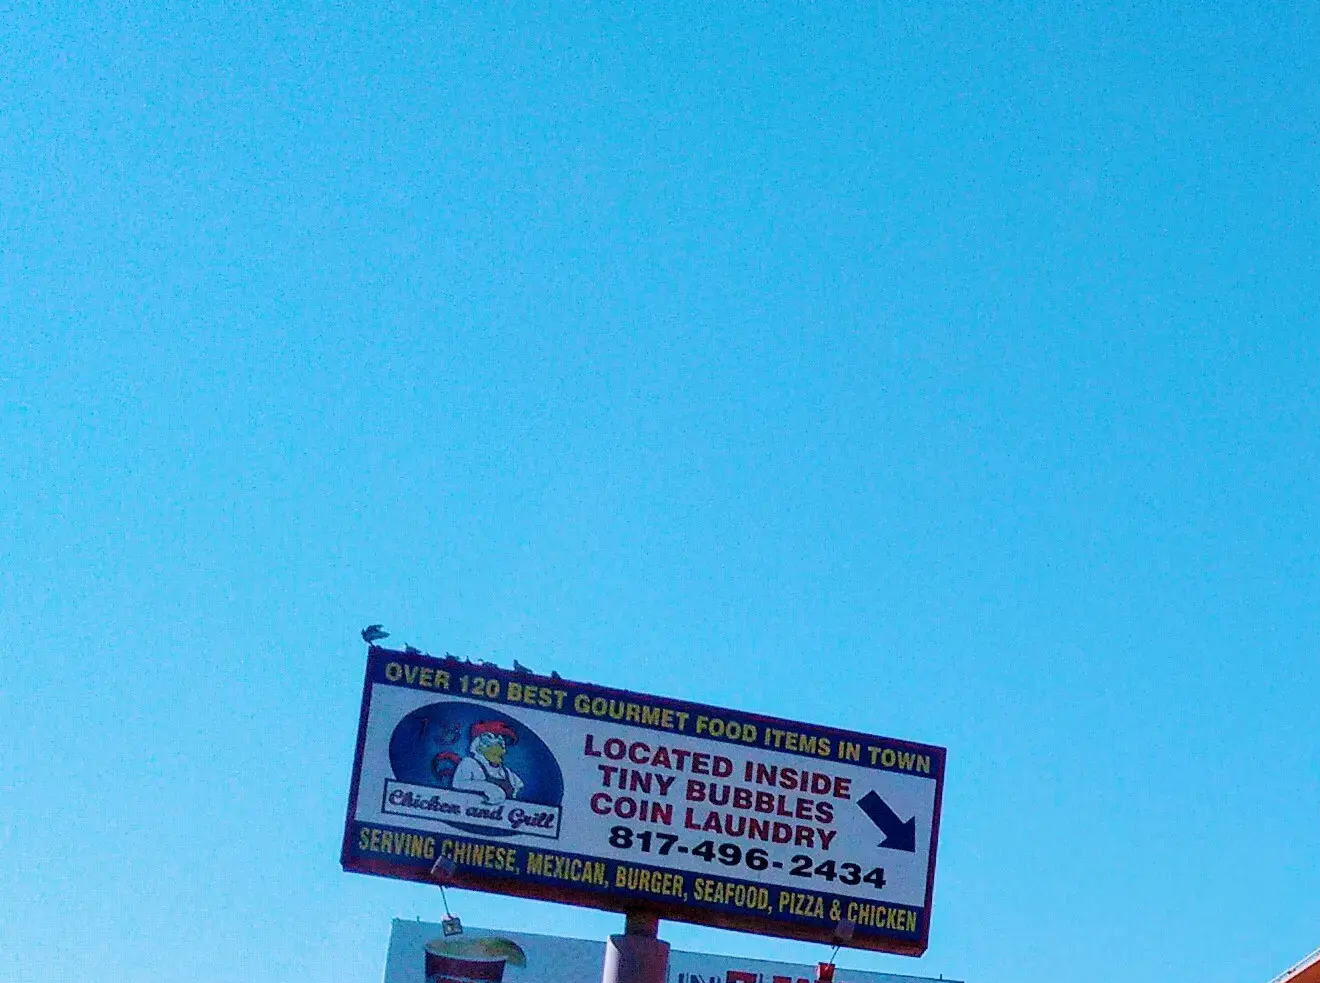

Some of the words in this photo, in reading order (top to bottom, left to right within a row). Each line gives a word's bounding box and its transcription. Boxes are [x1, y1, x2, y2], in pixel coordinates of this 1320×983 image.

[385, 662, 451, 690] OVER
[459, 675, 501, 698] 120
[507, 681, 568, 710] BEST
[574, 694, 689, 731] GOURMET
[696, 715, 757, 743] FOOD
[764, 728, 831, 757] ITEMS
[838, 741, 860, 762] IN
[868, 746, 931, 773] TOWN
[584, 734, 733, 778] LOCATED
[744, 761, 852, 800] INSIDE
[598, 764, 675, 796] TINY
[686, 779, 834, 824] BUBBLES
[388, 789, 461, 816] Chicken
[465, 803, 503, 821] and
[507, 808, 555, 829] Grill
[590, 792, 673, 826] COIN
[684, 807, 837, 850] LAUNDRY
[358, 827, 435, 860] SERVING
[441, 838, 520, 875] CHINESE,
[526, 851, 609, 888] MEXICAN,
[615, 865, 688, 901] BURGER,
[693, 878, 772, 914] SEAFOOD,
[779, 891, 825, 919] PIZZA
[829, 899, 841, 921] &
[847, 902, 917, 932] CHICKEN
[608, 826, 886, 889] 817-496-2434
